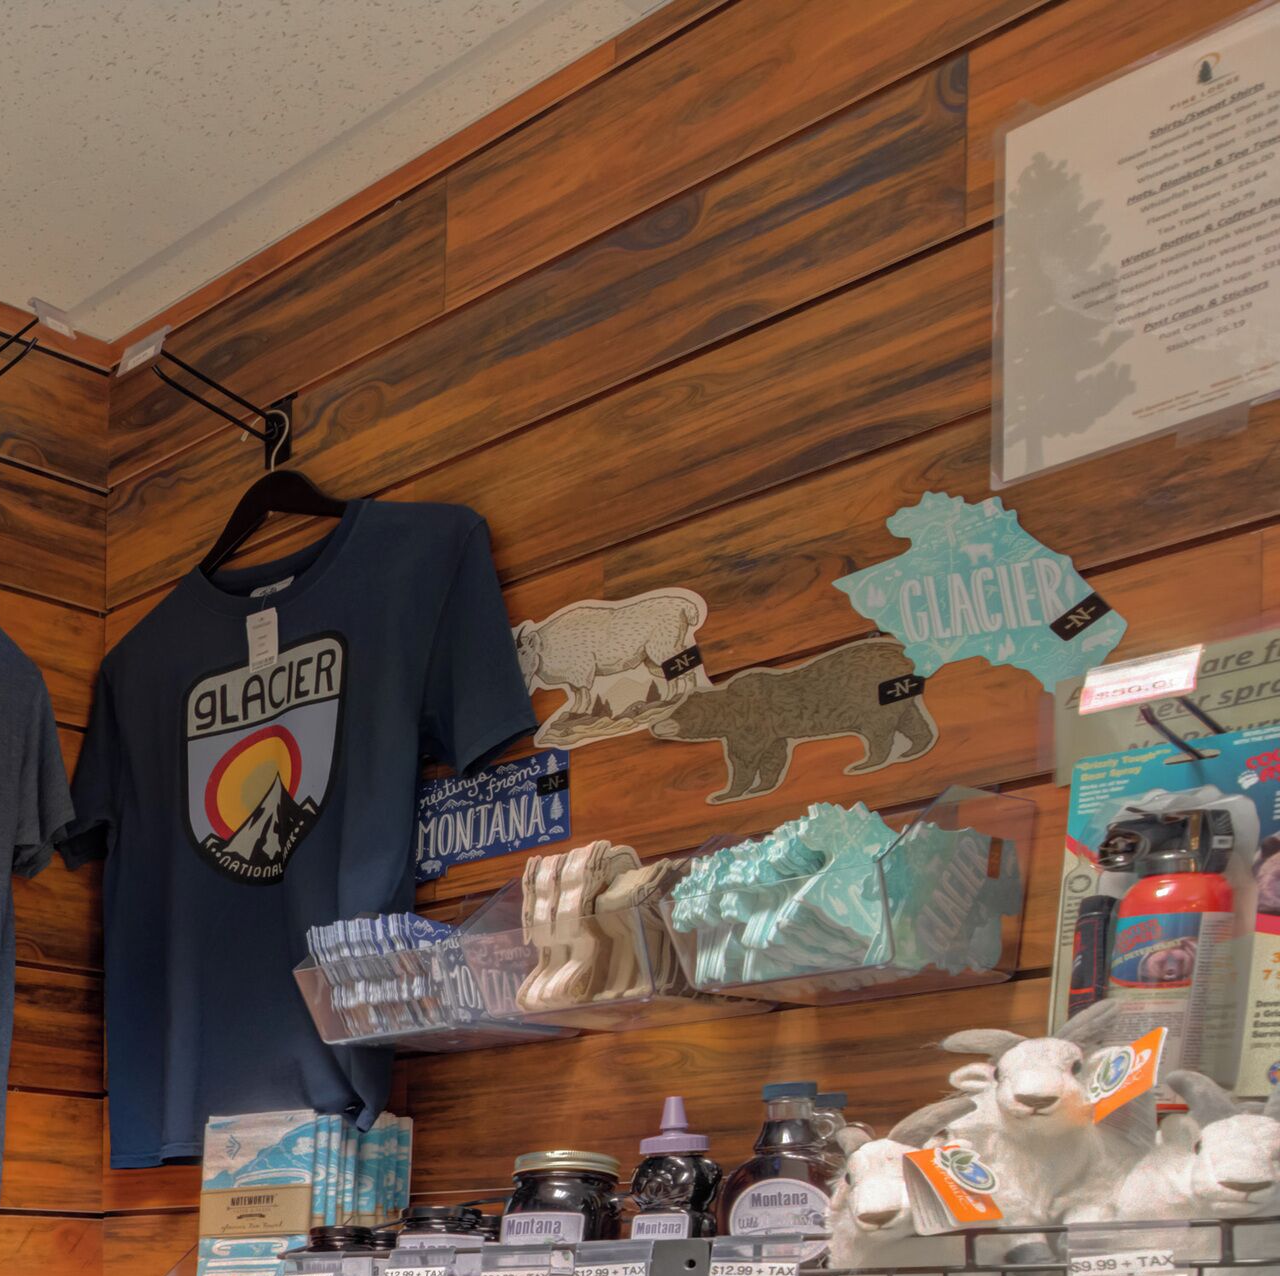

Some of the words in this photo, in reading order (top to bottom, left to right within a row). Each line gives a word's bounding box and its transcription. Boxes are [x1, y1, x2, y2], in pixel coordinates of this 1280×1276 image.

[1230, 82, 1265, 102] Shirts
[900, 557, 1067, 643] GLACIER
[1201, 651, 1251, 675] are
[193, 648, 337, 732] GLACIER
[486, 764, 540, 801] from
[416, 792, 546, 862] MONTANA
[219, 854, 284, 879] NATIONAL
[282, 832, 298, 864] ARK
[231, 1194, 274, 1207] NOTEWORTHY
[751, 1191, 808, 1208] Montana
[506, 1218, 562, 1235] Montana
[636, 1220, 682, 1235] Montana
[622, 1265, 644, 1276] TAX
[711, 1265, 753, 1276] $12.99
[768, 1265, 795, 1276] TAX
[1071, 1258, 1116, 1275] $9.99
[1138, 1254, 1175, 1270] TAX
